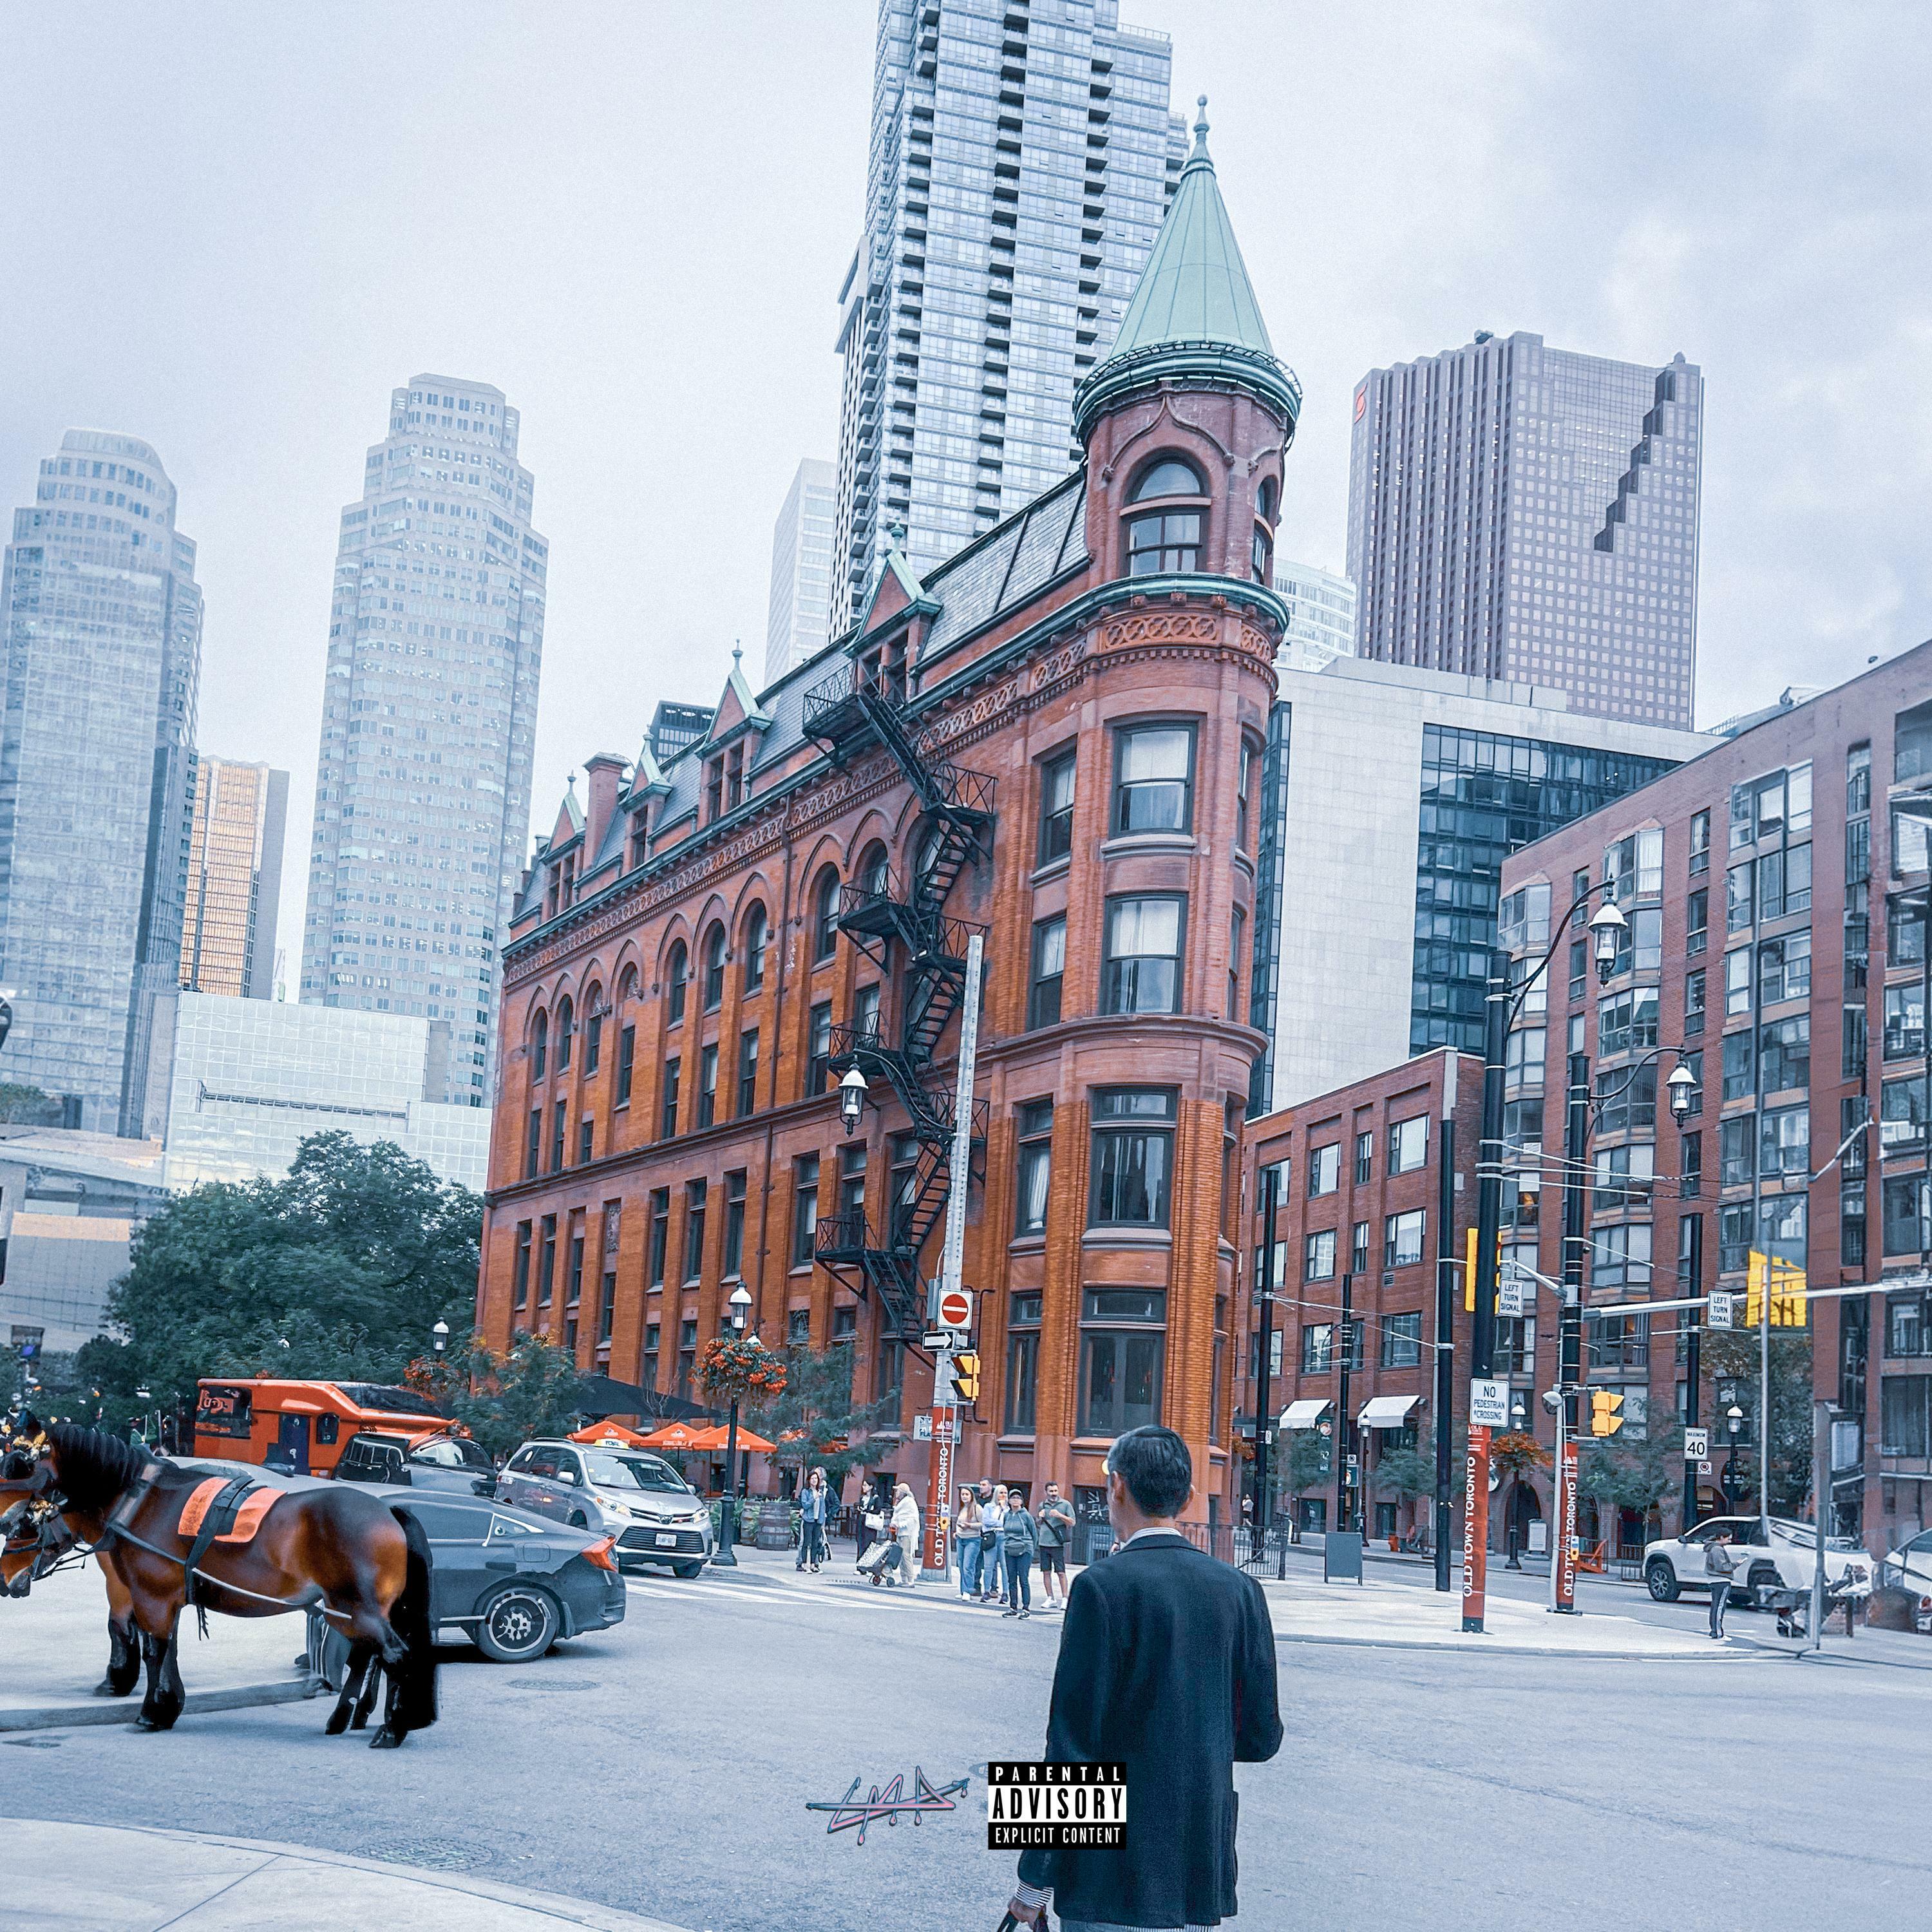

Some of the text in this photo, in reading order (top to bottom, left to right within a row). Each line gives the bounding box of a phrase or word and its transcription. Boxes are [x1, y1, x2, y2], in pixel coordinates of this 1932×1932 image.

[1504, 1293, 1519, 1302] TURN
[1501, 1303, 1520, 1312] SIGNAL
[1710, 1315, 1730, 1323] SIGNAL
[1483, 1386, 1496, 1398] NO
[1473, 1399, 1505, 1409] PEDESTRIAN
[1687, 1441, 1705, 1455] 40
[938, 1448, 949, 1501] TORONTO
[1566, 1481, 1577, 1532] TORONTO
[1463, 1456, 1476, 1597] OLD TOWN TORONTO
[934, 1539, 944, 1566] OLD
[1564, 1569, 1573, 1596] OLD
